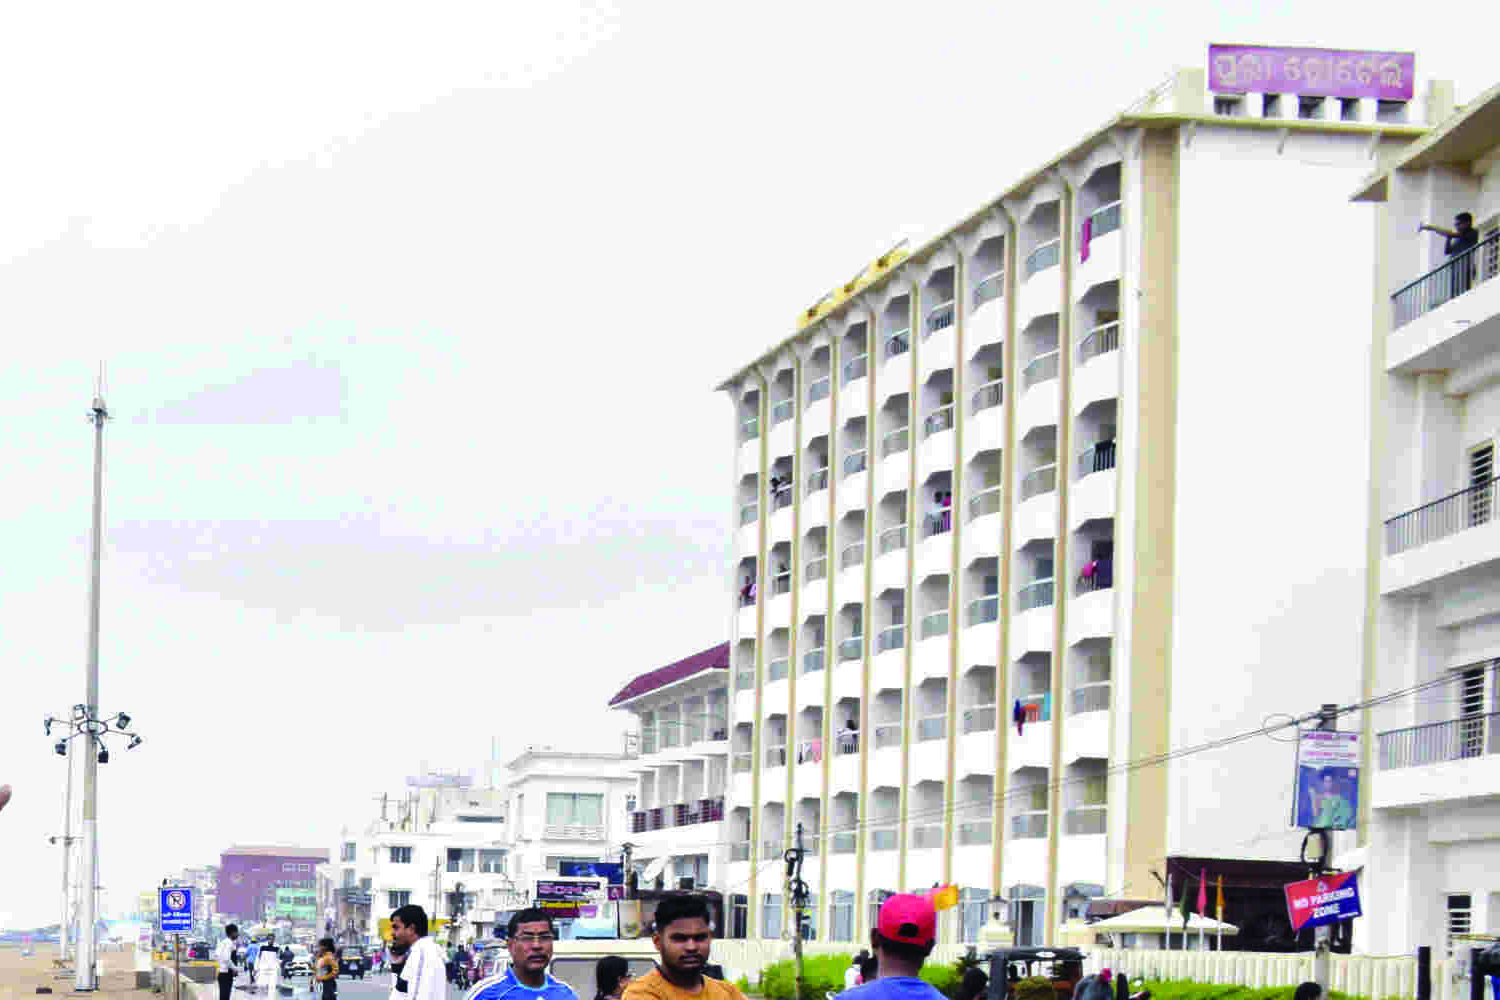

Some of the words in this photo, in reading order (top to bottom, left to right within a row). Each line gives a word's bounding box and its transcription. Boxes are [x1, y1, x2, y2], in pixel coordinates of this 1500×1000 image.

[1292, 898, 1308, 909] NO
[1309, 888, 1355, 905] PARKING
[1314, 903, 1340, 918] ZONE
